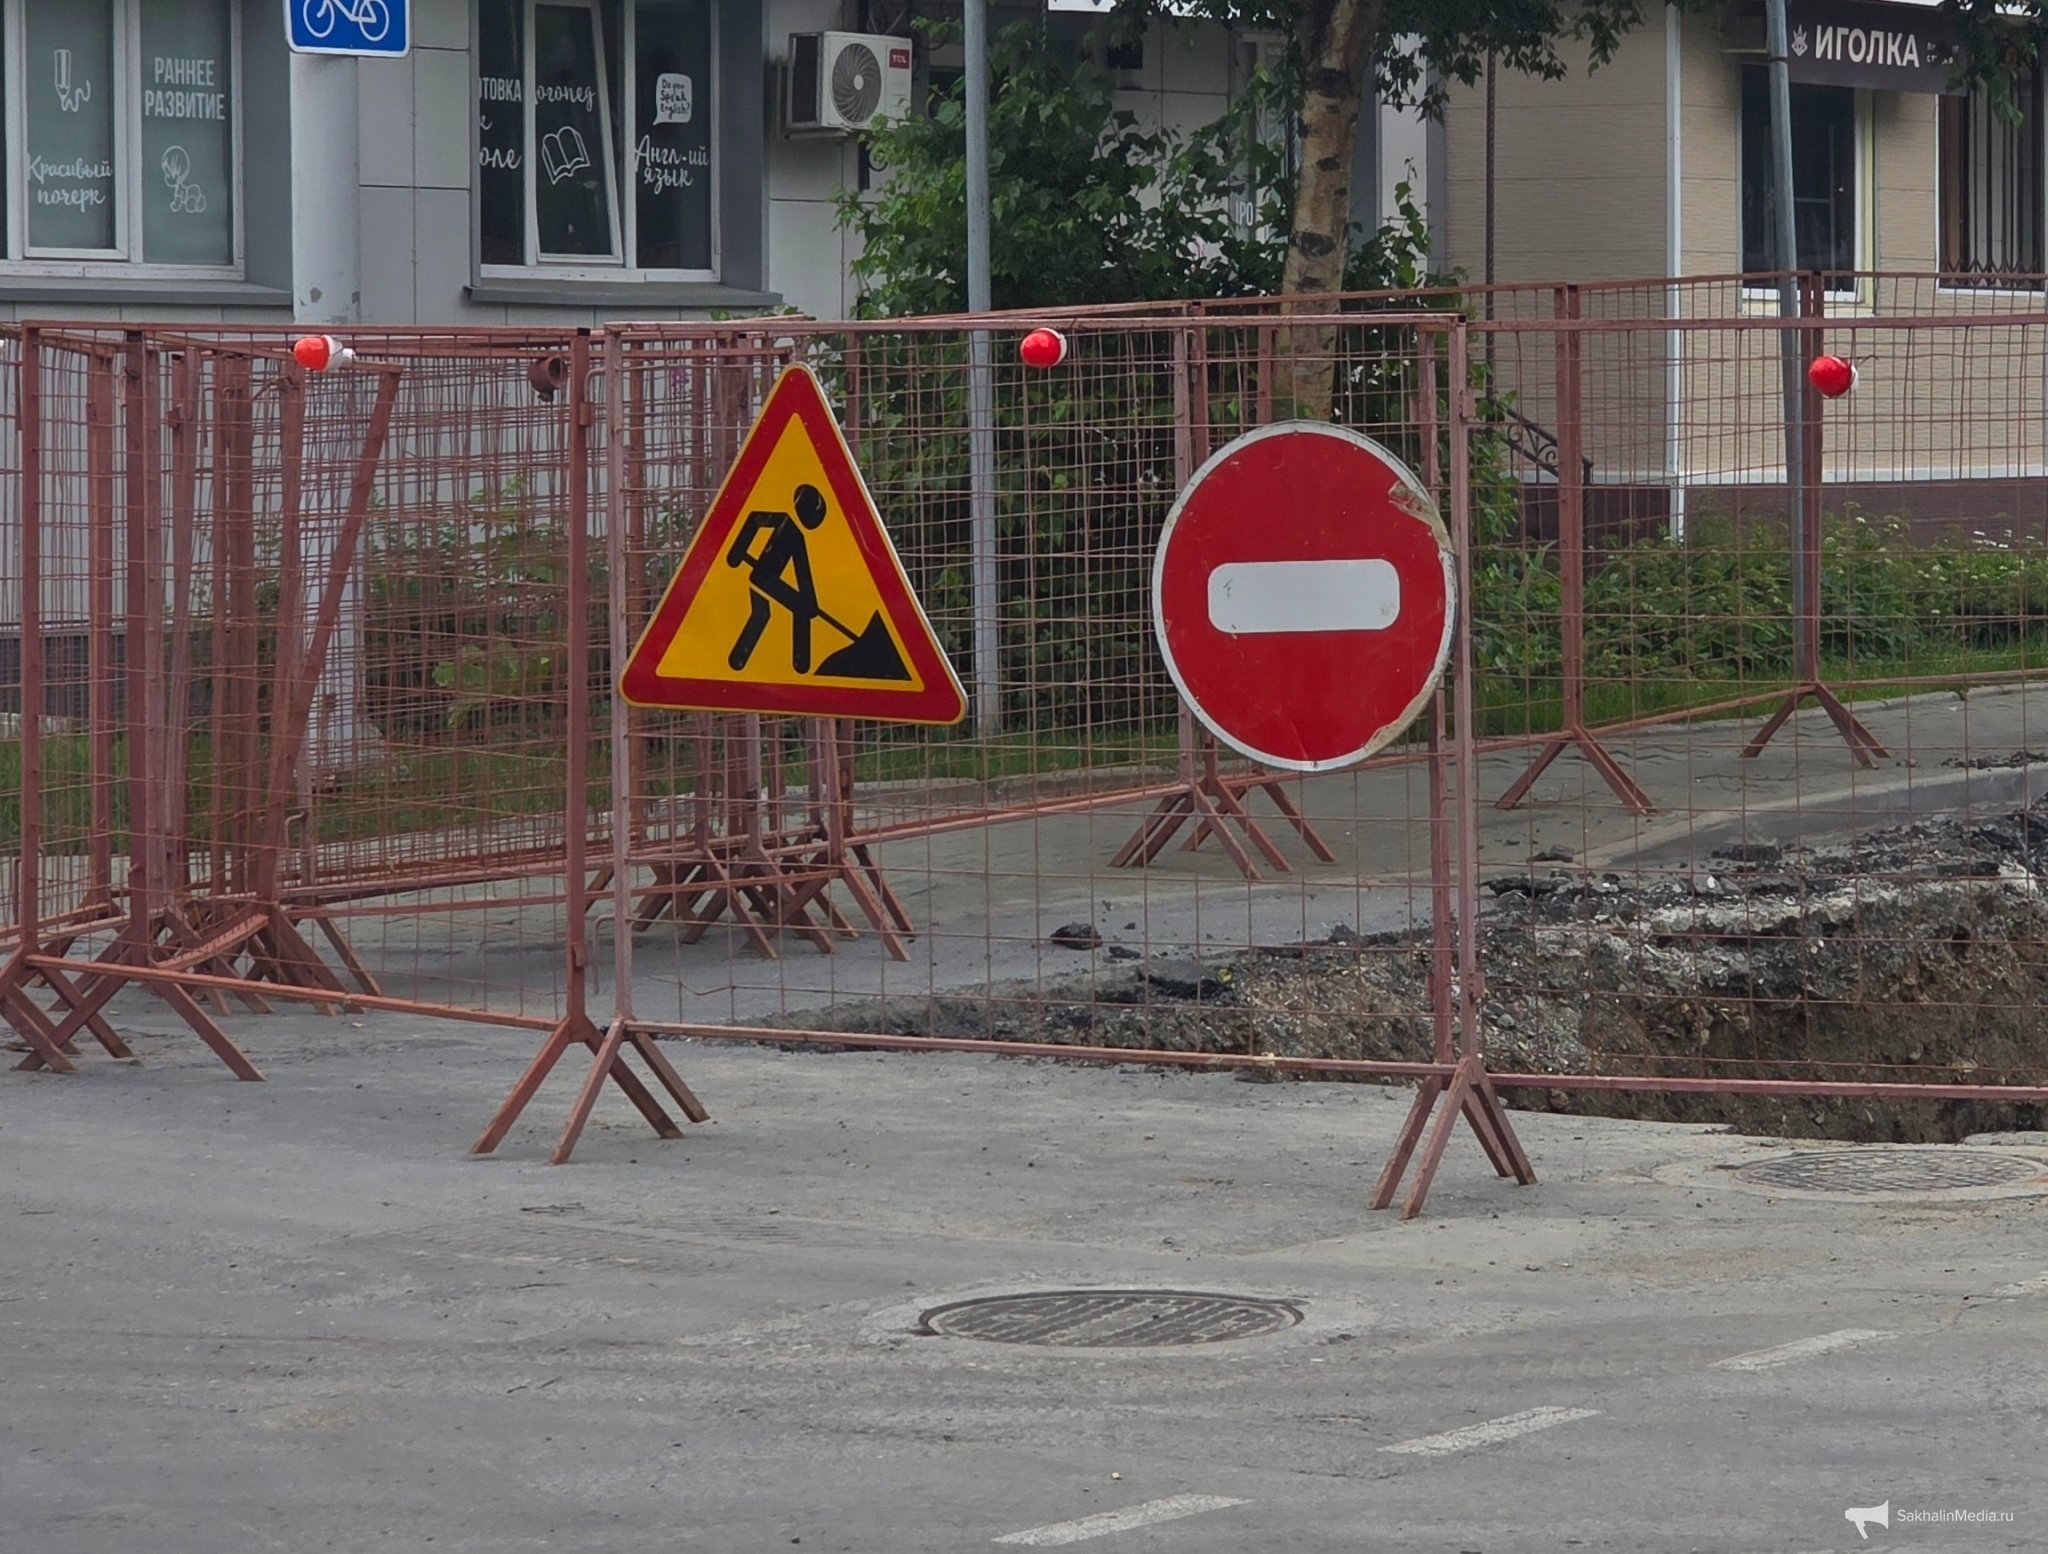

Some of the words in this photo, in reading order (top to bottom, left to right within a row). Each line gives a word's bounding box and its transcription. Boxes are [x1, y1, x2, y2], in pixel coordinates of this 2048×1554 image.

[892, 54, 907, 64] TCL
[1815, 24, 1920, 68] ИГОЛКА
[154, 57, 215, 87] РАННЕЕ
[144, 89, 226, 120] РАЗВИТИЕ
[535, 84, 596, 112] огопед
[25, 152, 113, 184] Красивый
[635, 134, 709, 173] Англ-ий
[643, 166, 694, 195] язык
[37, 187, 106, 213] почерк
